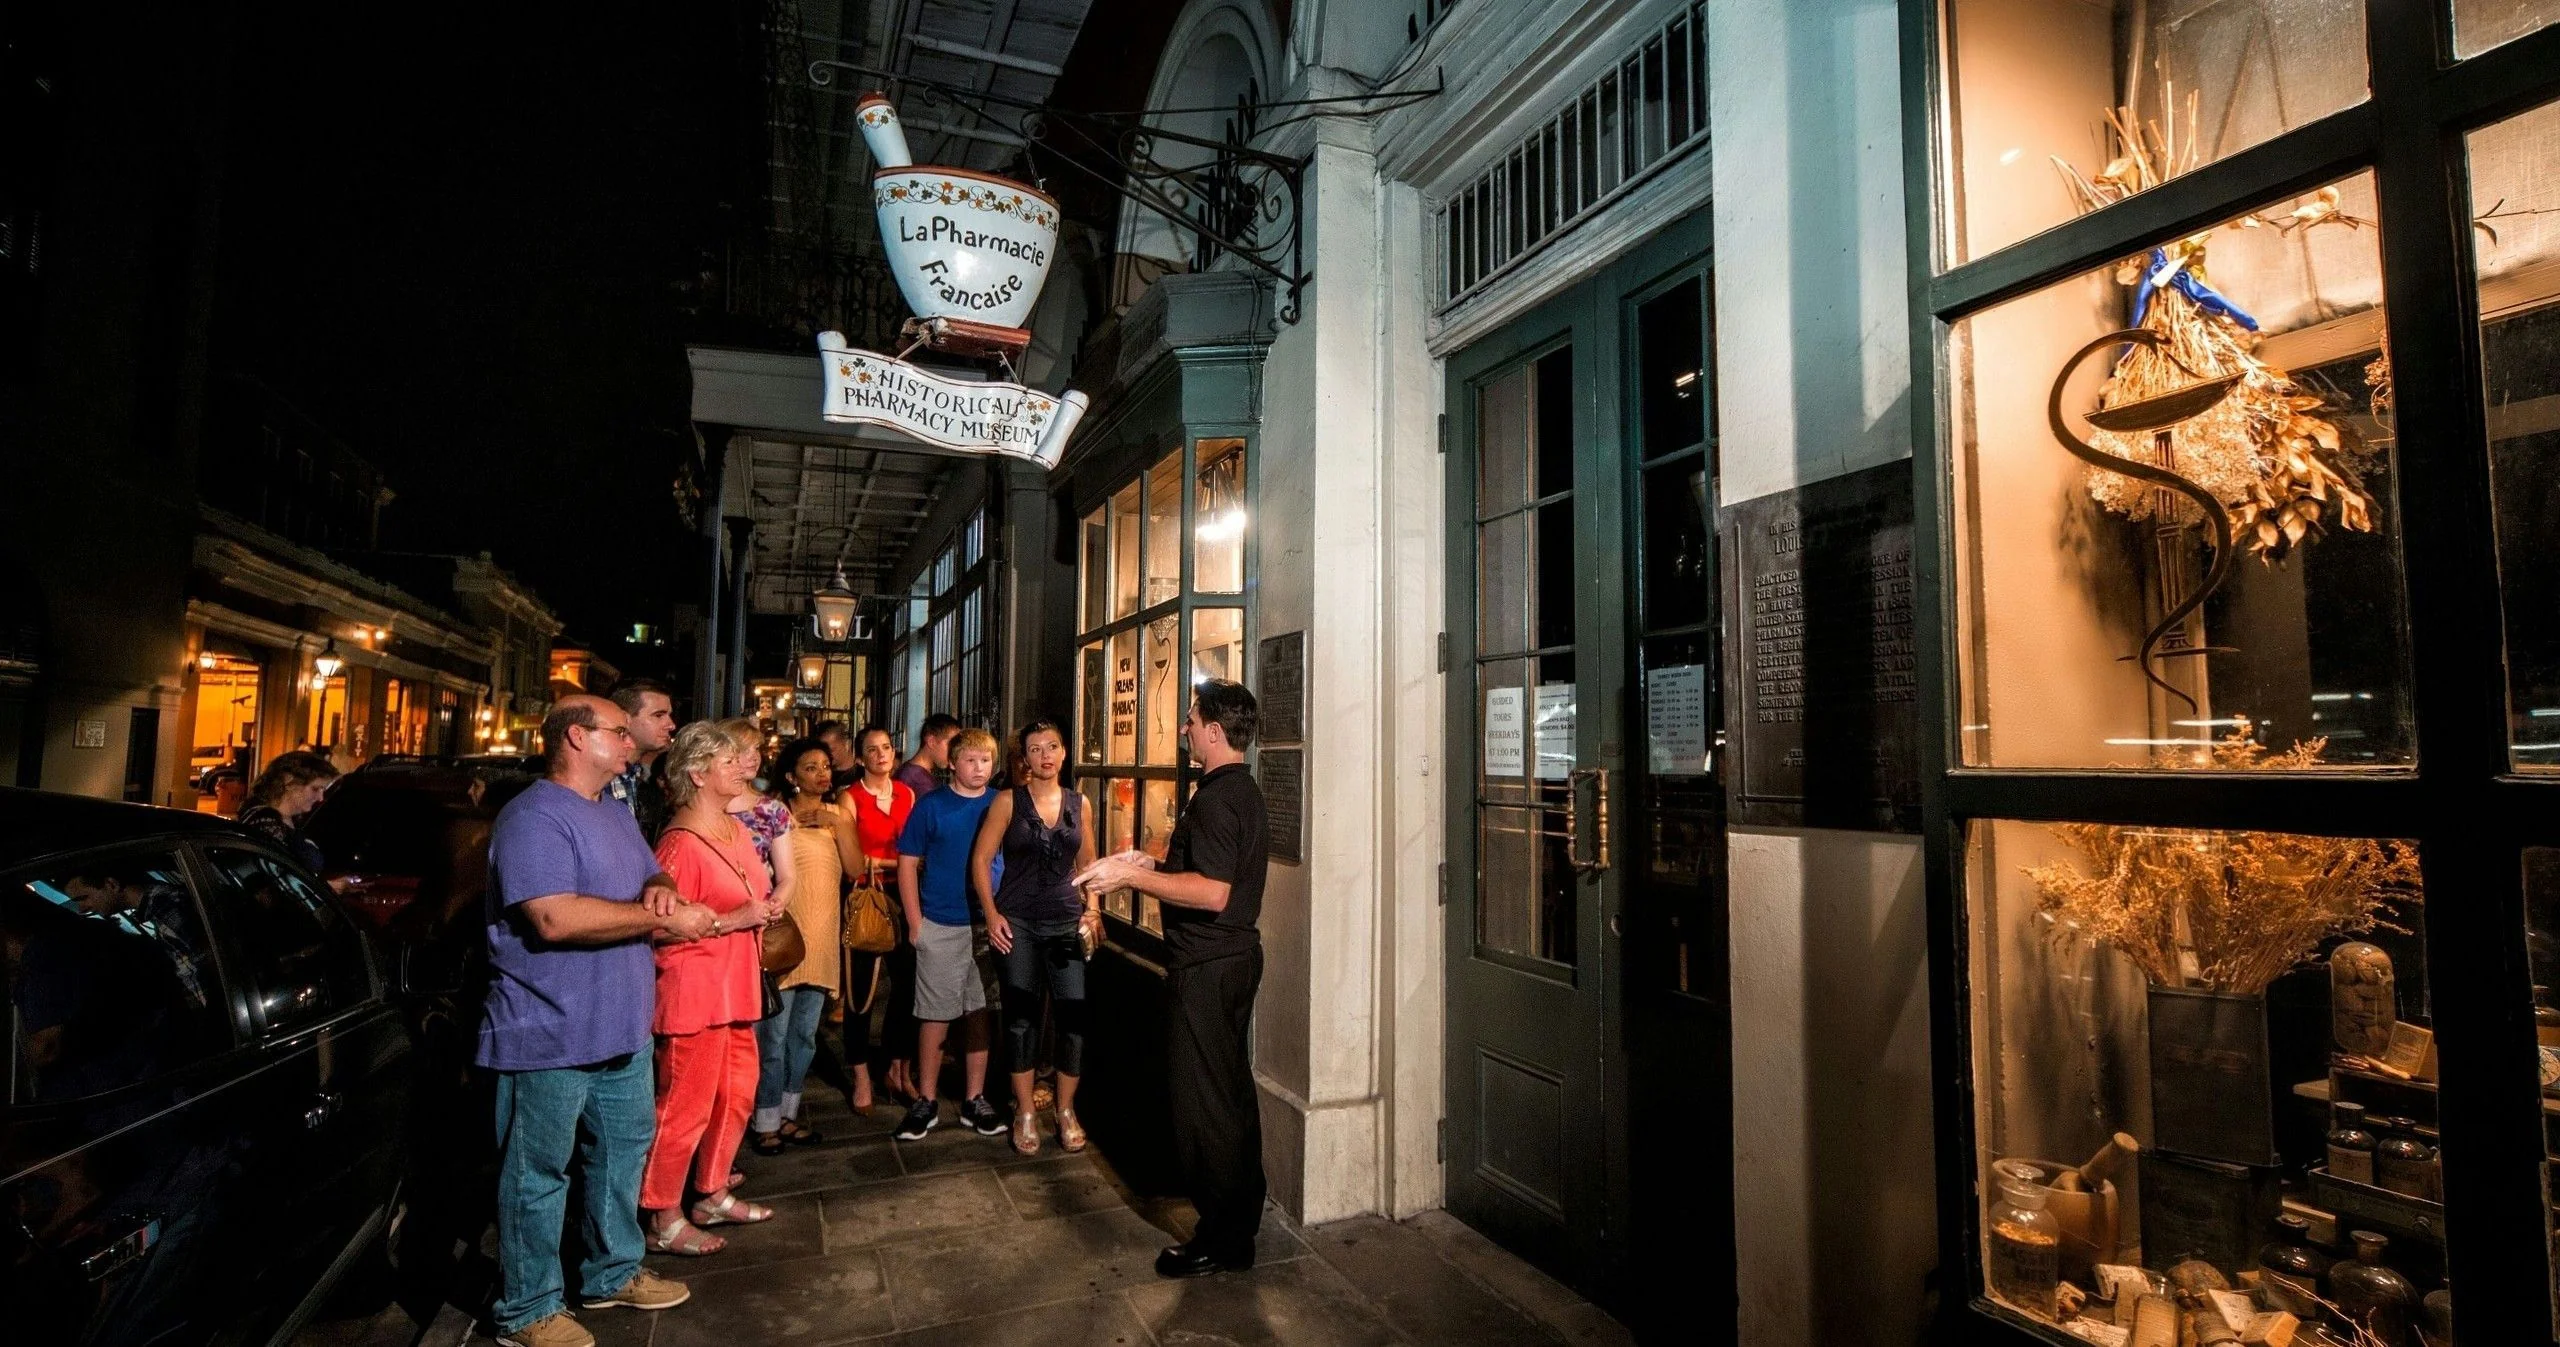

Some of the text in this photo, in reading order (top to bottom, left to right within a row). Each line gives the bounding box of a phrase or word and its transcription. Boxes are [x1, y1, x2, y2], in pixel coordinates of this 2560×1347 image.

[900, 216, 1046, 267] La Pharmacie
[919, 258, 1023, 311] Francaise
[878, 369, 1021, 418] HISTORICAL
[843, 387, 1041, 447] PHARMACY MUSEUM
[1755, 588, 1772, 601] THE
[1777, 584, 1802, 597] FIRST
[1770, 597, 1793, 612] HAVE
[1755, 612, 1783, 628] UNITED
[1756, 641, 1773, 654] THE
[1119, 657, 1131, 673] NEW
